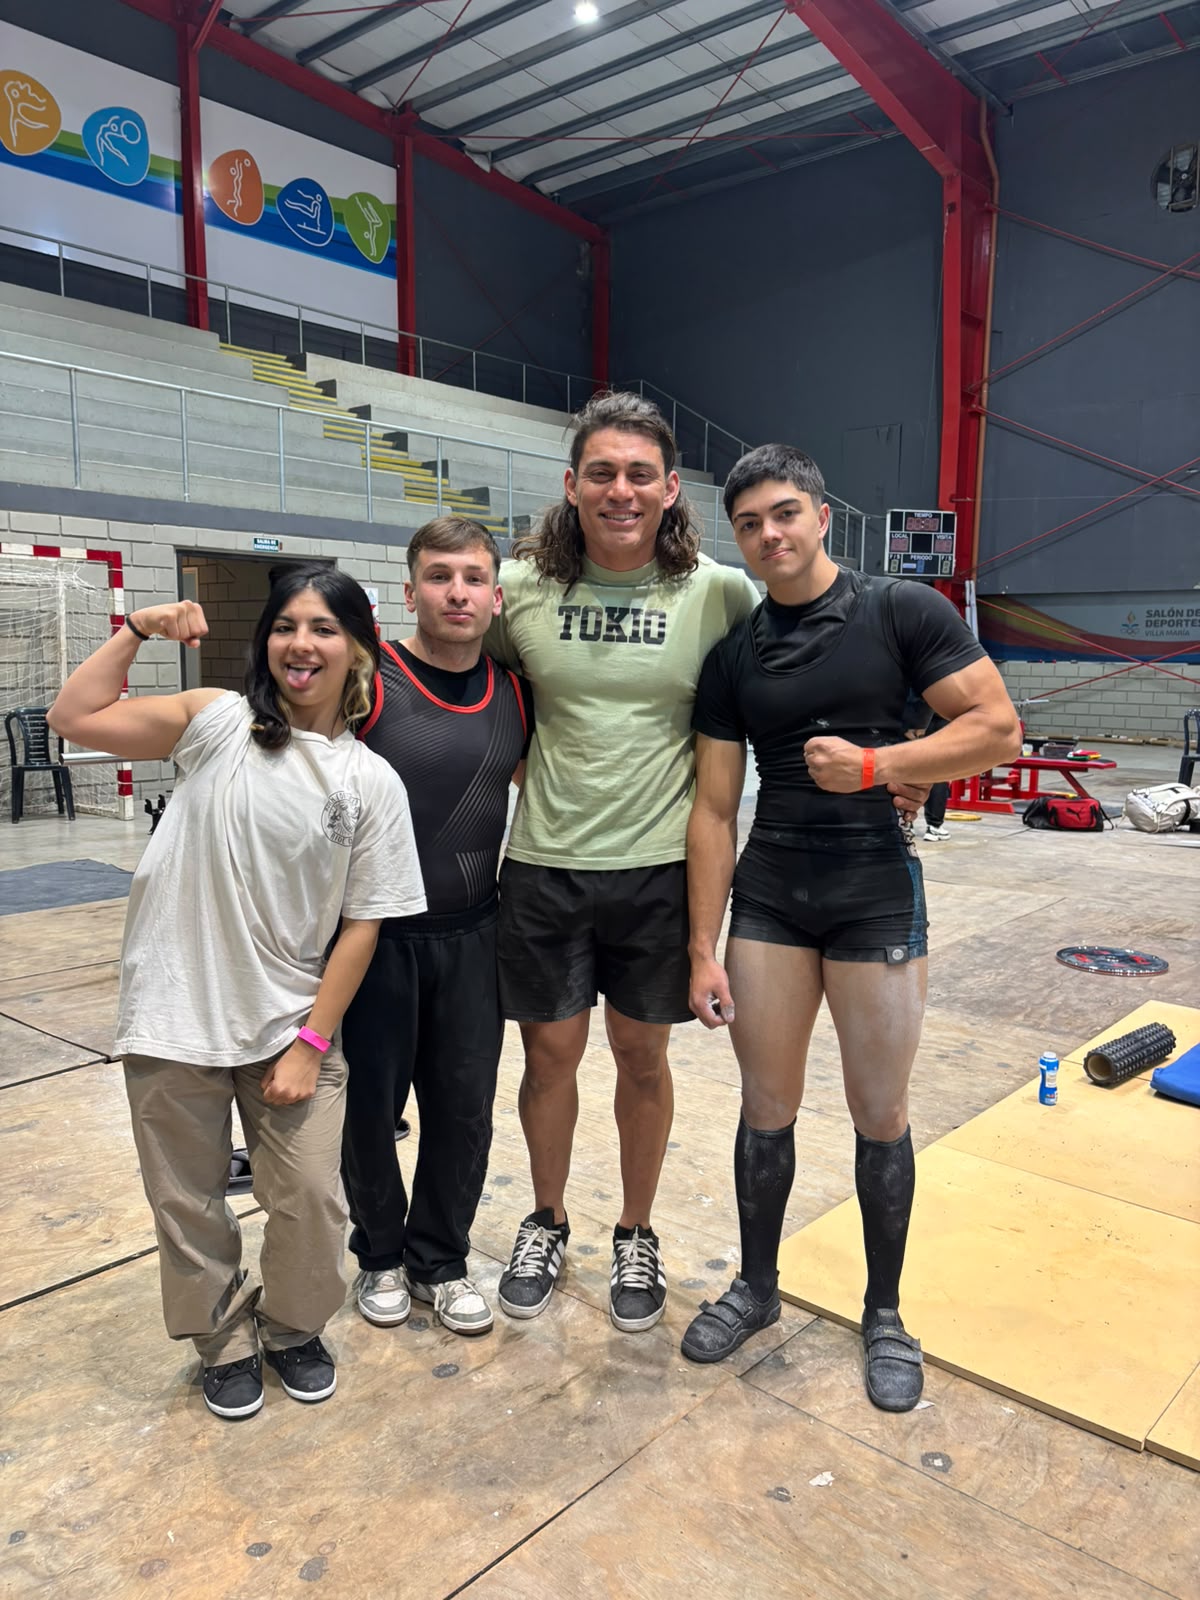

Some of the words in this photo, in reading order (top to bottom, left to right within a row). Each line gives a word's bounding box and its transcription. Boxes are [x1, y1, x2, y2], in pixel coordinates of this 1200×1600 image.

[1145, 606, 1184, 618] SALÓN
[1186, 608, 1200, 618] DE
[557, 605, 667, 645] TOKIO
[1145, 618, 1200, 628] DEPORTE
